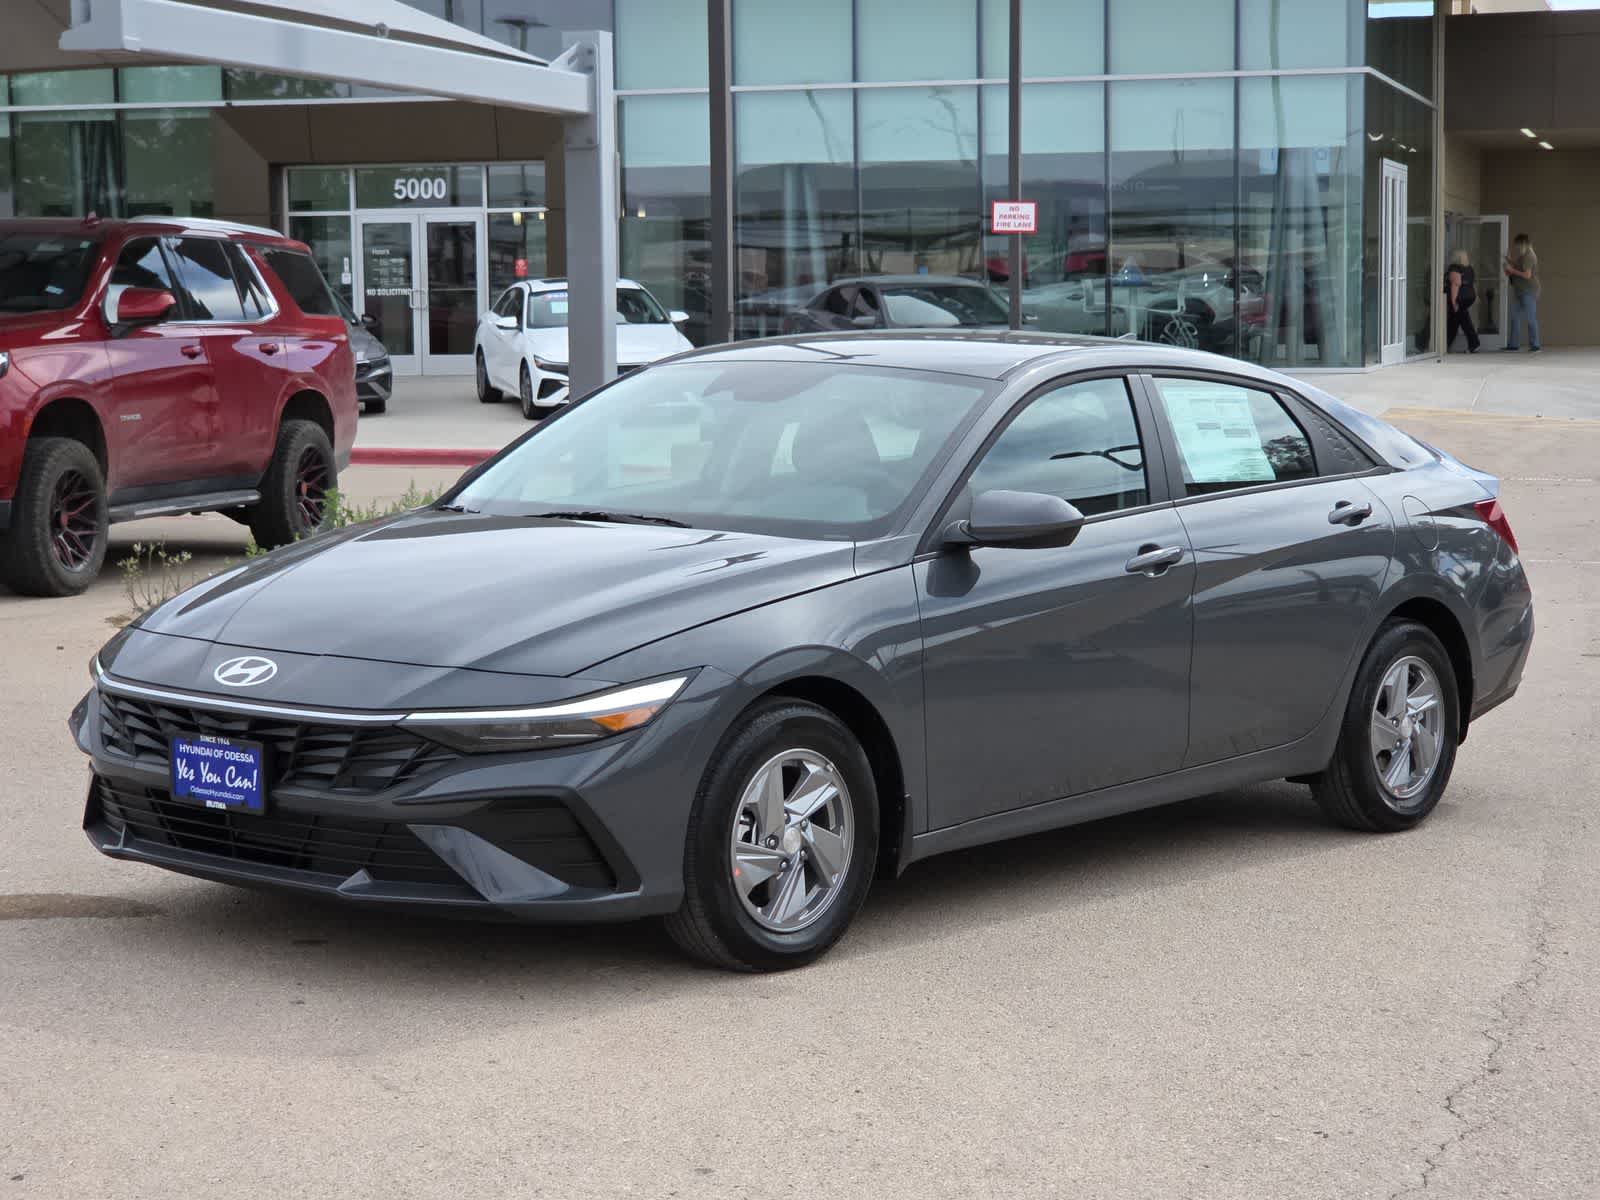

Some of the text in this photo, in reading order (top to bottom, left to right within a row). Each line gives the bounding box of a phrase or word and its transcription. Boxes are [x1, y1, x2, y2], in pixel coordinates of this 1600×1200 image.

[393, 177, 447, 200] 5000
[366, 287, 376, 296] NO
[200, 735, 217, 744] SINCE
[179, 743, 254, 763] HYUNDAI OF ODESSA
[176, 757, 258, 792] Yes You Can!
